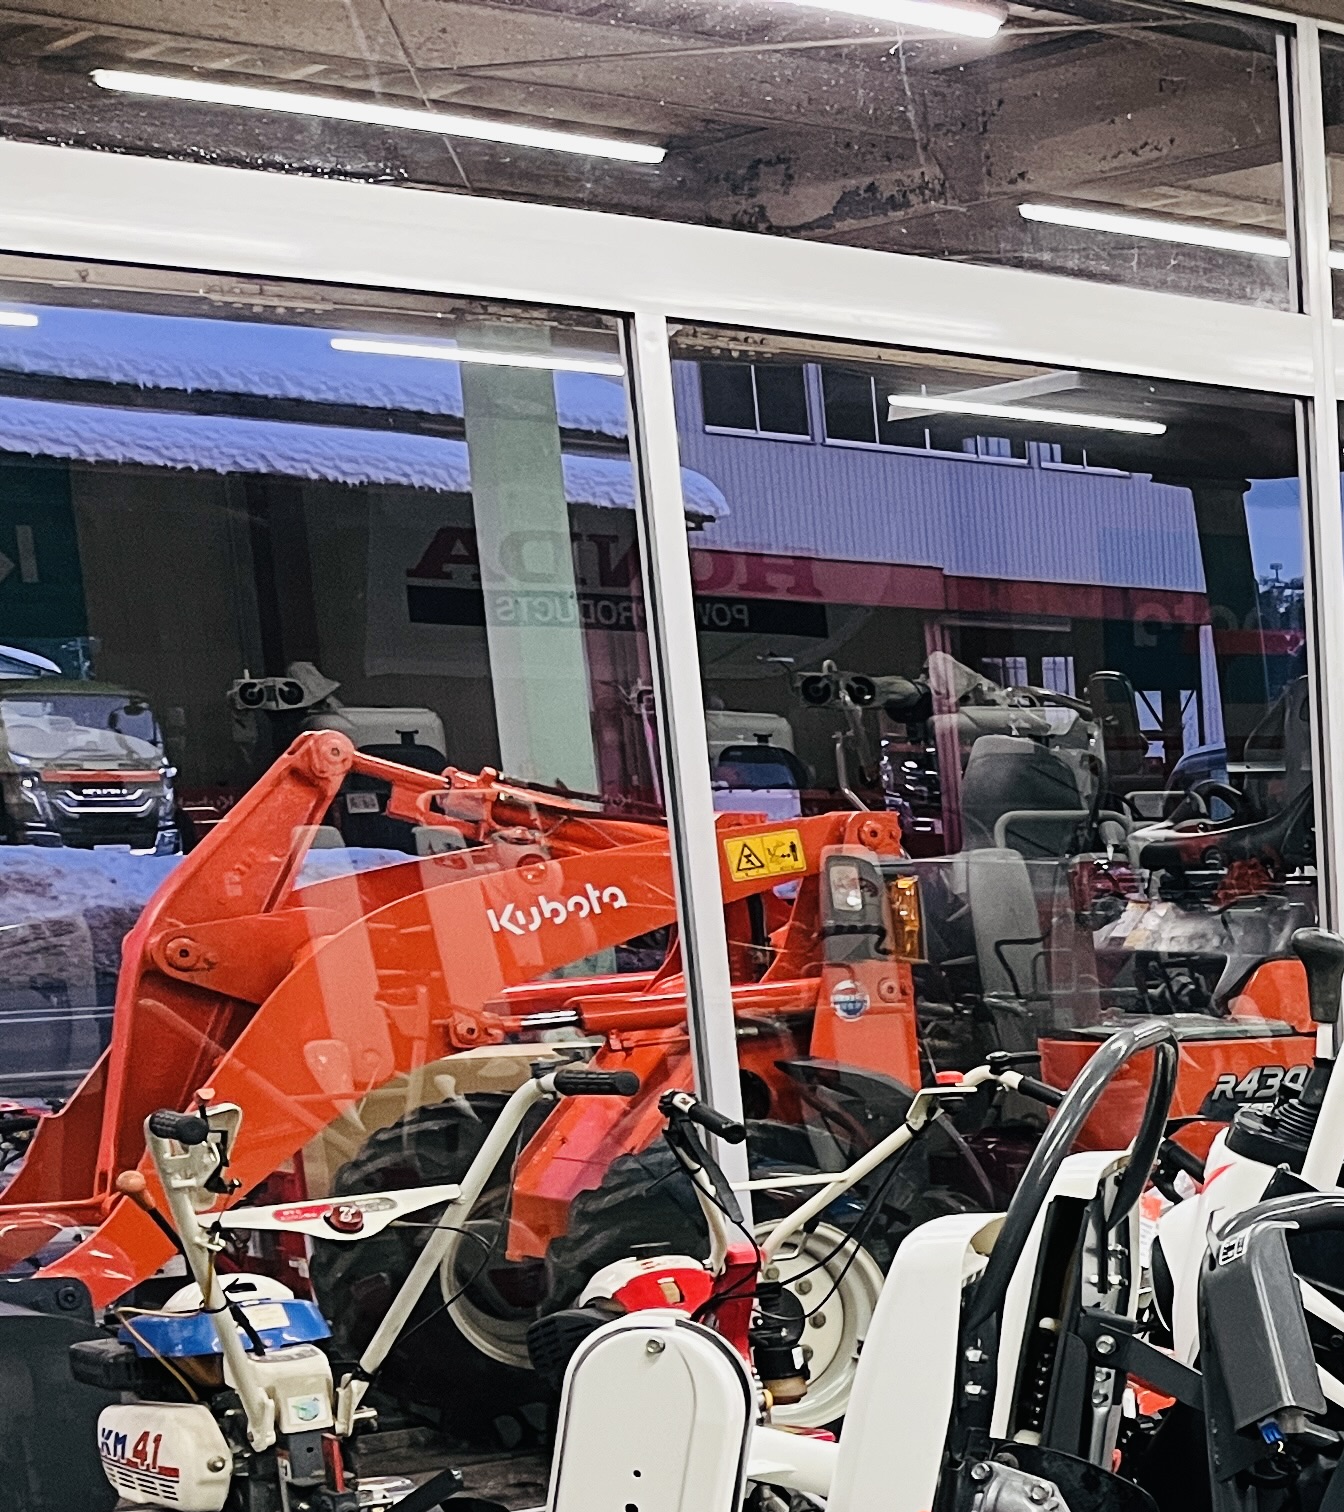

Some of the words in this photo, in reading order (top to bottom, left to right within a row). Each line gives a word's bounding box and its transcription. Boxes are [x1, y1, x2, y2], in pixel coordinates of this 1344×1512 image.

[487, 881, 628, 936] Kubota
[101, 1427, 128, 1460] KM
[132, 1430, 163, 1470] 41
